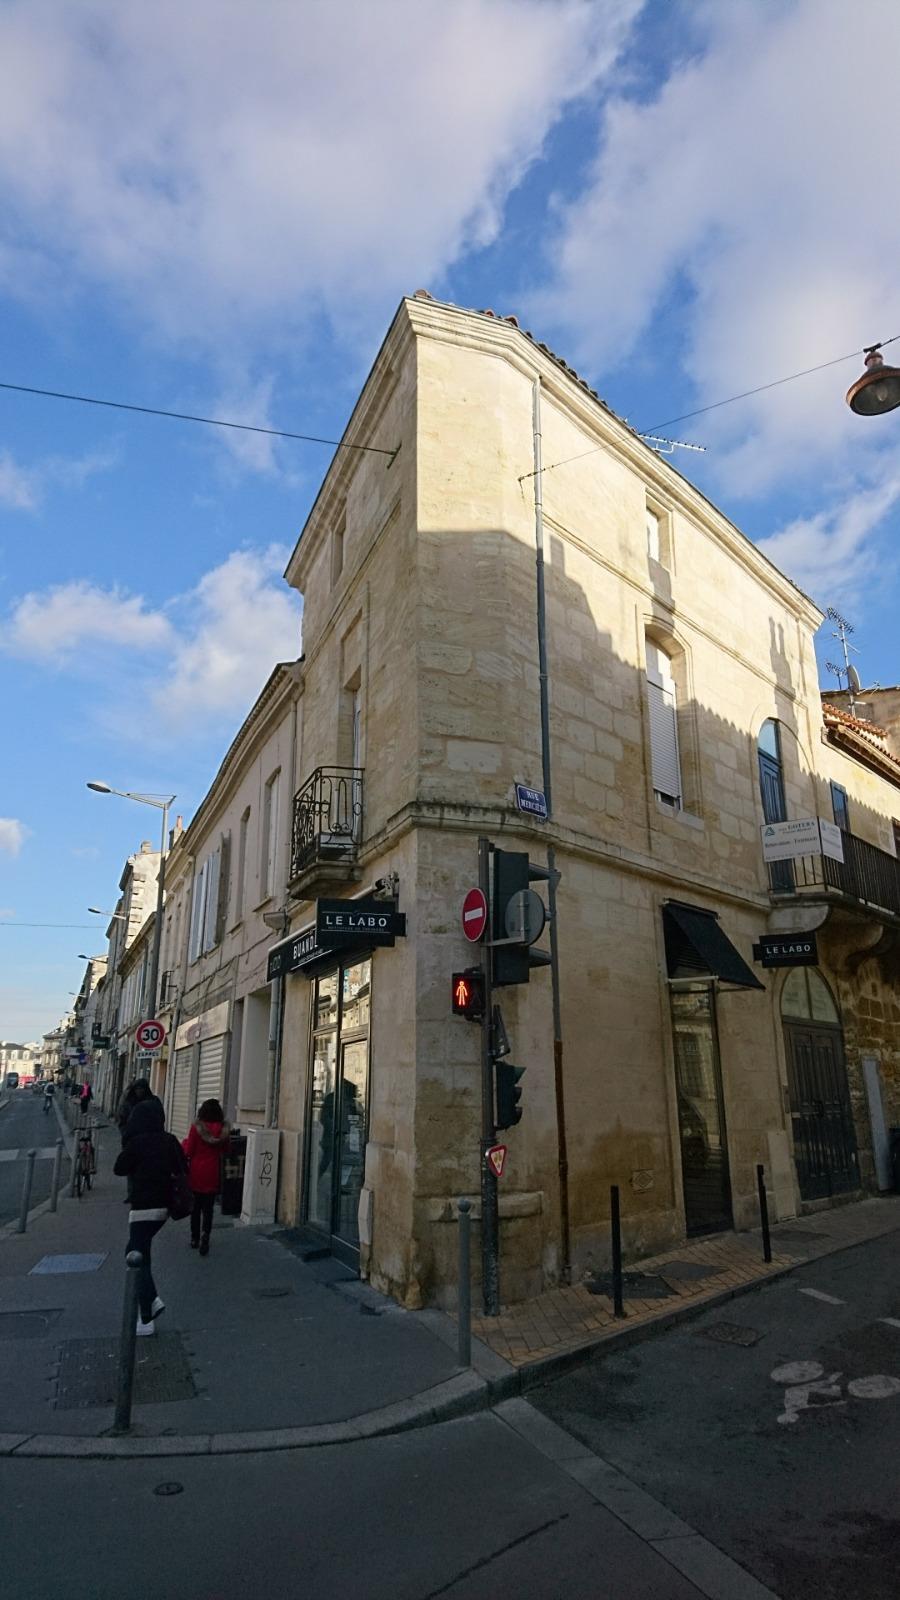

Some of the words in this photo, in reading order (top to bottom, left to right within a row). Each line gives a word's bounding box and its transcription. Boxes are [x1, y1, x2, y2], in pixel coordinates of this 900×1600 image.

[326, 915, 343, 925] LE
[349, 916, 387, 927] LABO
[293, 935, 317, 960] BUAND
[766, 946, 779, 954] LE
[782, 944, 811, 954] LABO
[142, 1029, 159, 1041] 30
